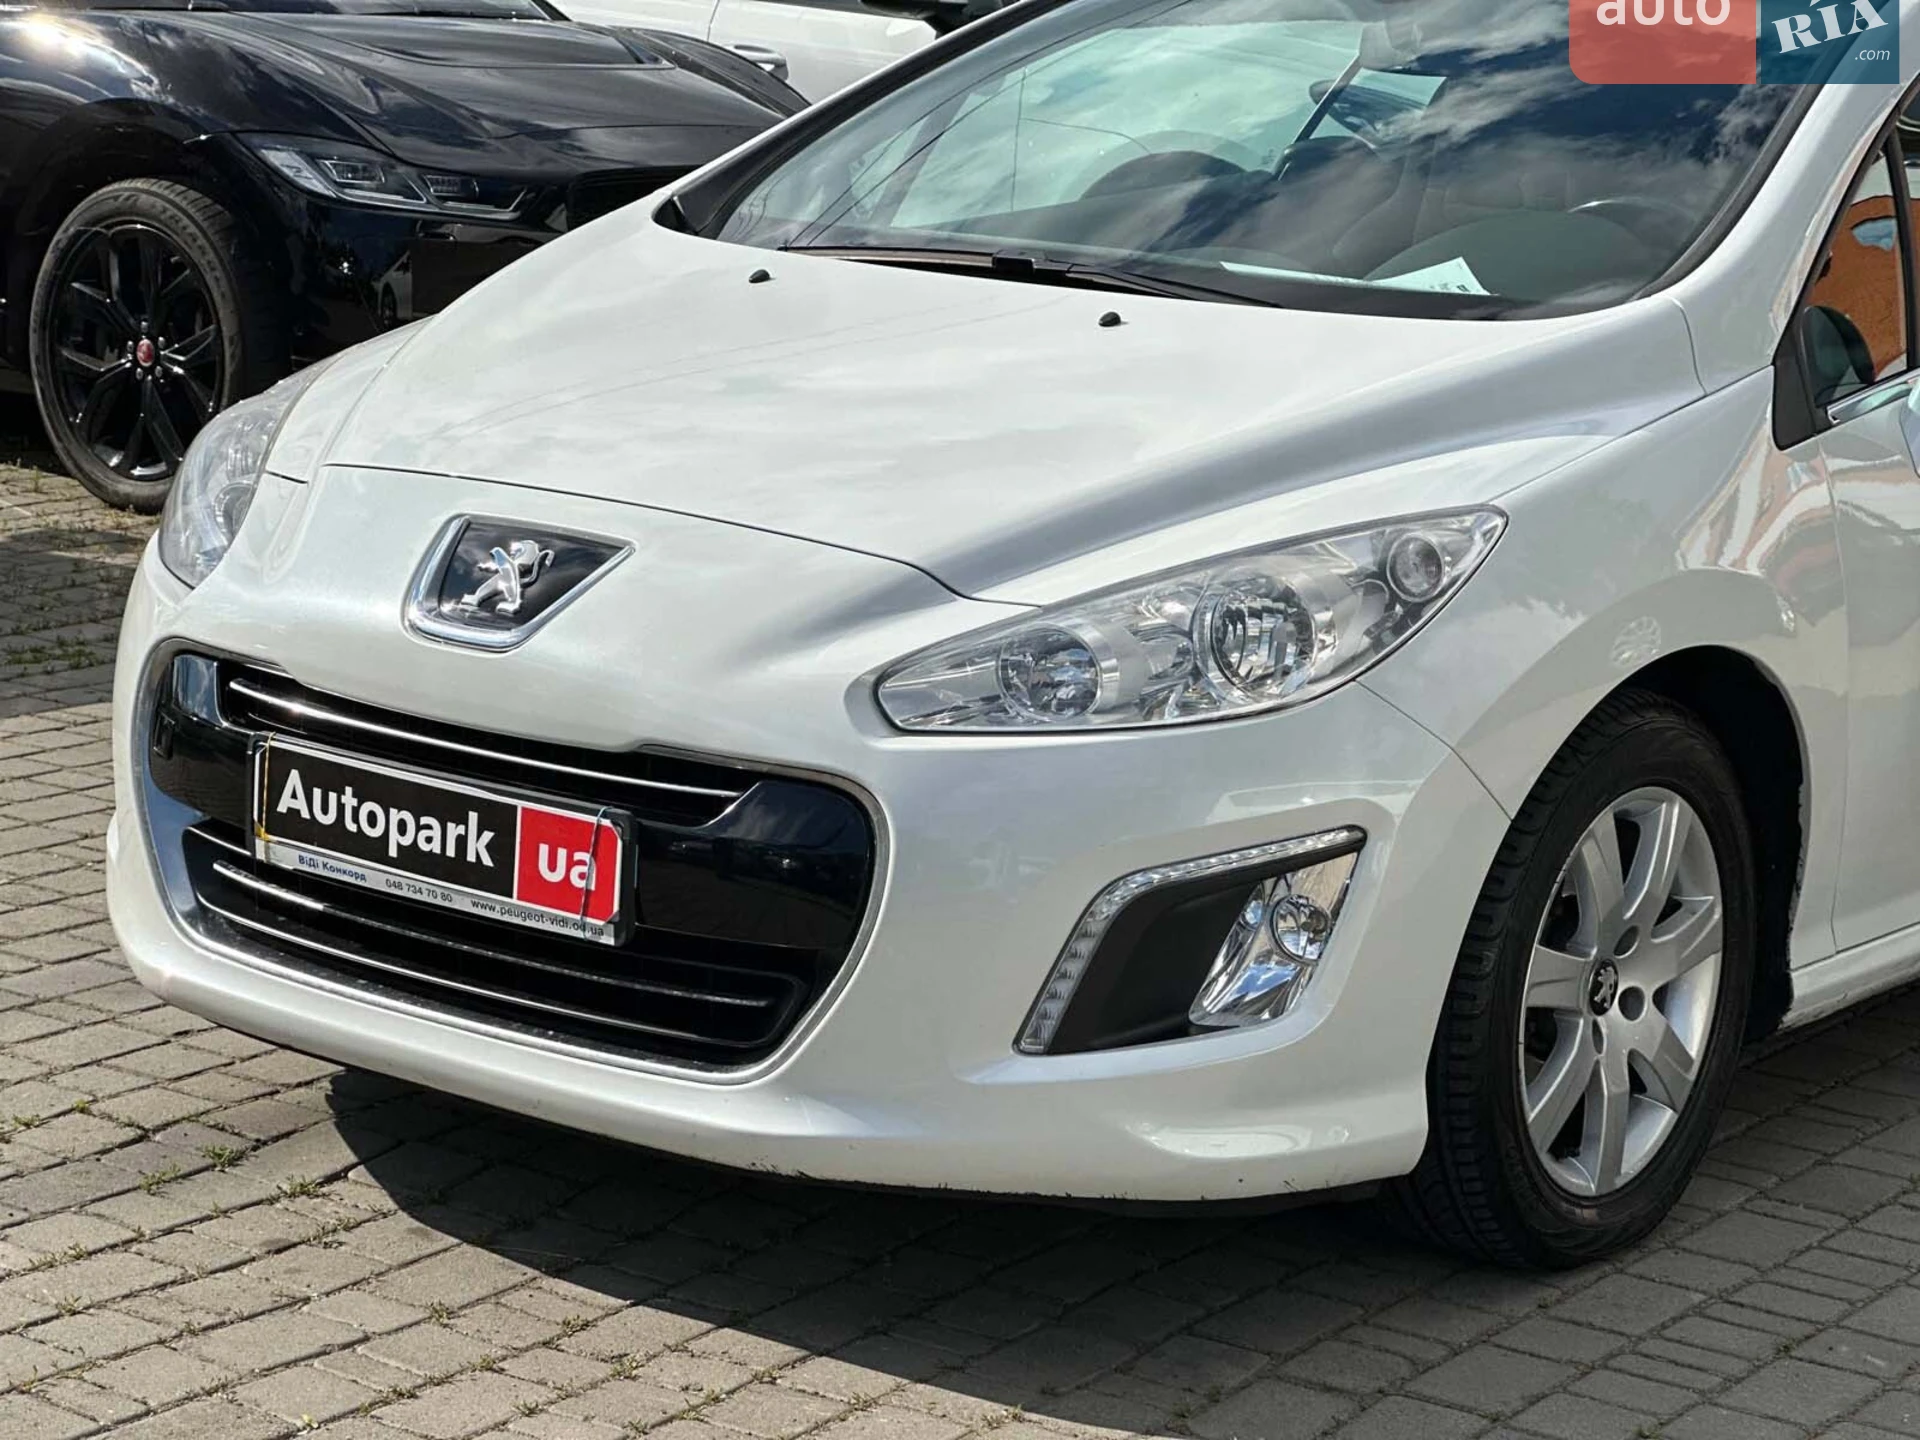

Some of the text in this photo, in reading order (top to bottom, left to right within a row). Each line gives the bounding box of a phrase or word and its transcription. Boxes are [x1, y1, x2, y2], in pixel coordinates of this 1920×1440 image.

[276, 768, 496, 868] Autopark
[322, 860, 368, 883] Конкорд
[537, 842, 598, 892] ua
[405, 883, 424, 896] 734
[425, 887, 438, 900] 70
[470, 898, 605, 937] www.peugeot-vidi.od.ua
